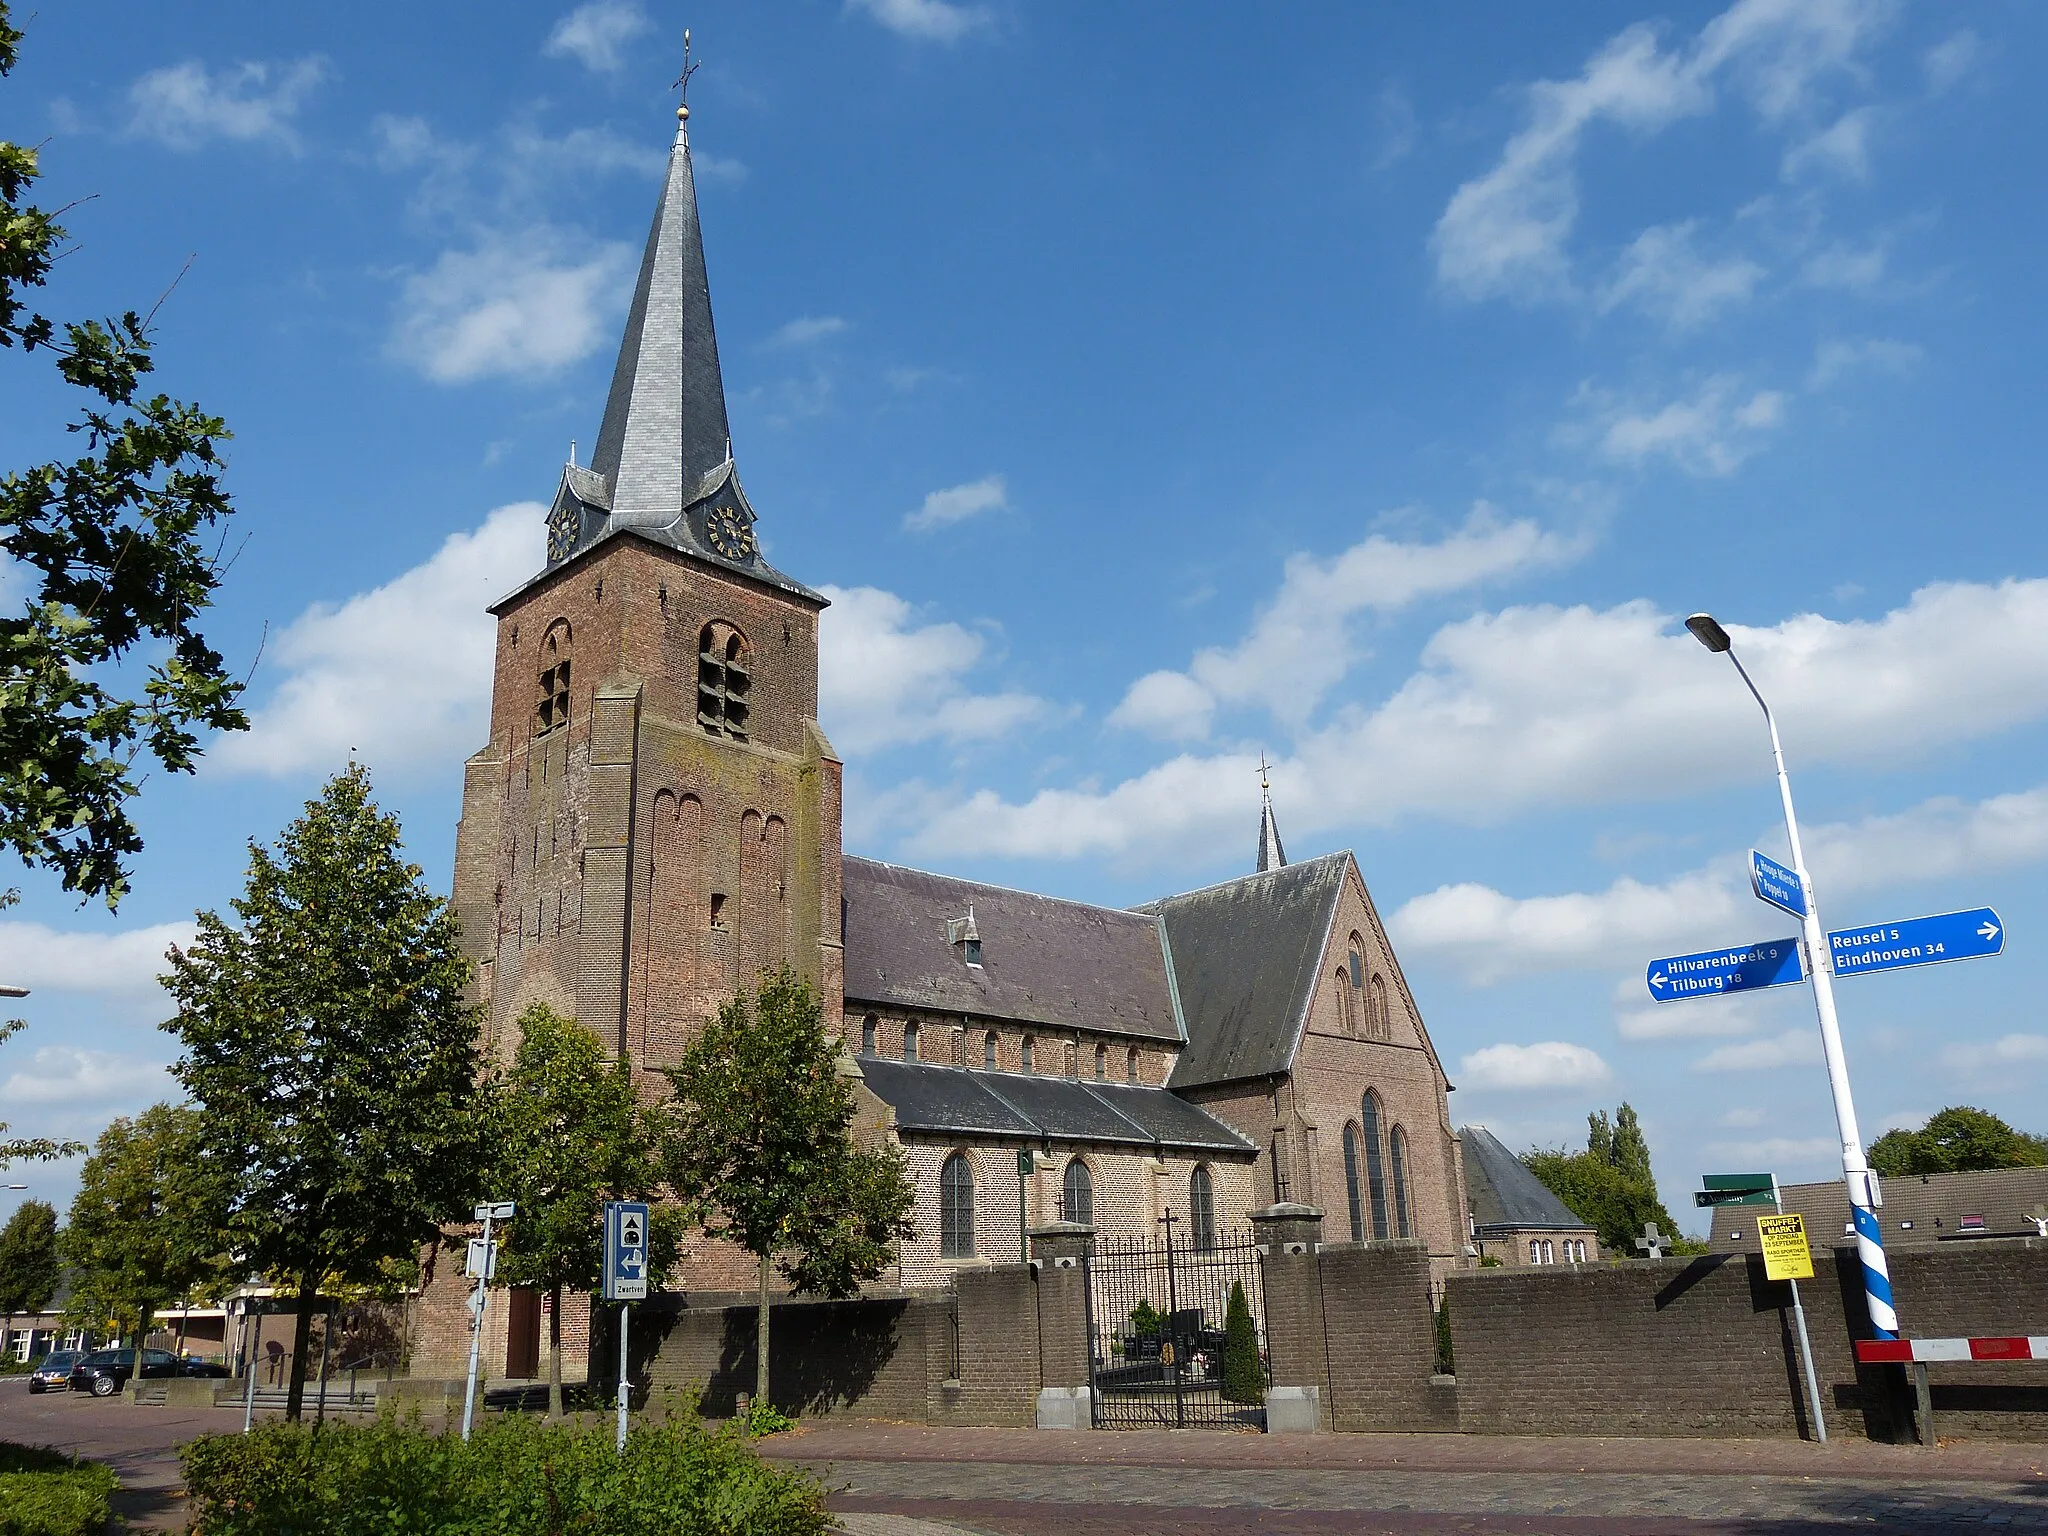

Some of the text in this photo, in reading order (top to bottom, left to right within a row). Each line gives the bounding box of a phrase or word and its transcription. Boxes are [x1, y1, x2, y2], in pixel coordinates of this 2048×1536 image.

[1832, 929, 1900, 949] Reusel 5
[1667, 948, 1778, 974] Hilvarenbeek 9
[1835, 942, 1945, 968] Eindhoven 34
[1669, 973, 1742, 992] Tilburg 18
[1761, 1218, 1800, 1227] SNUFFEL-
[1767, 1225, 1797, 1235] MARKT
[1772, 1239, 1804, 1247] SEPTEMBER
[617, 1285, 644, 1293] Zwartven
